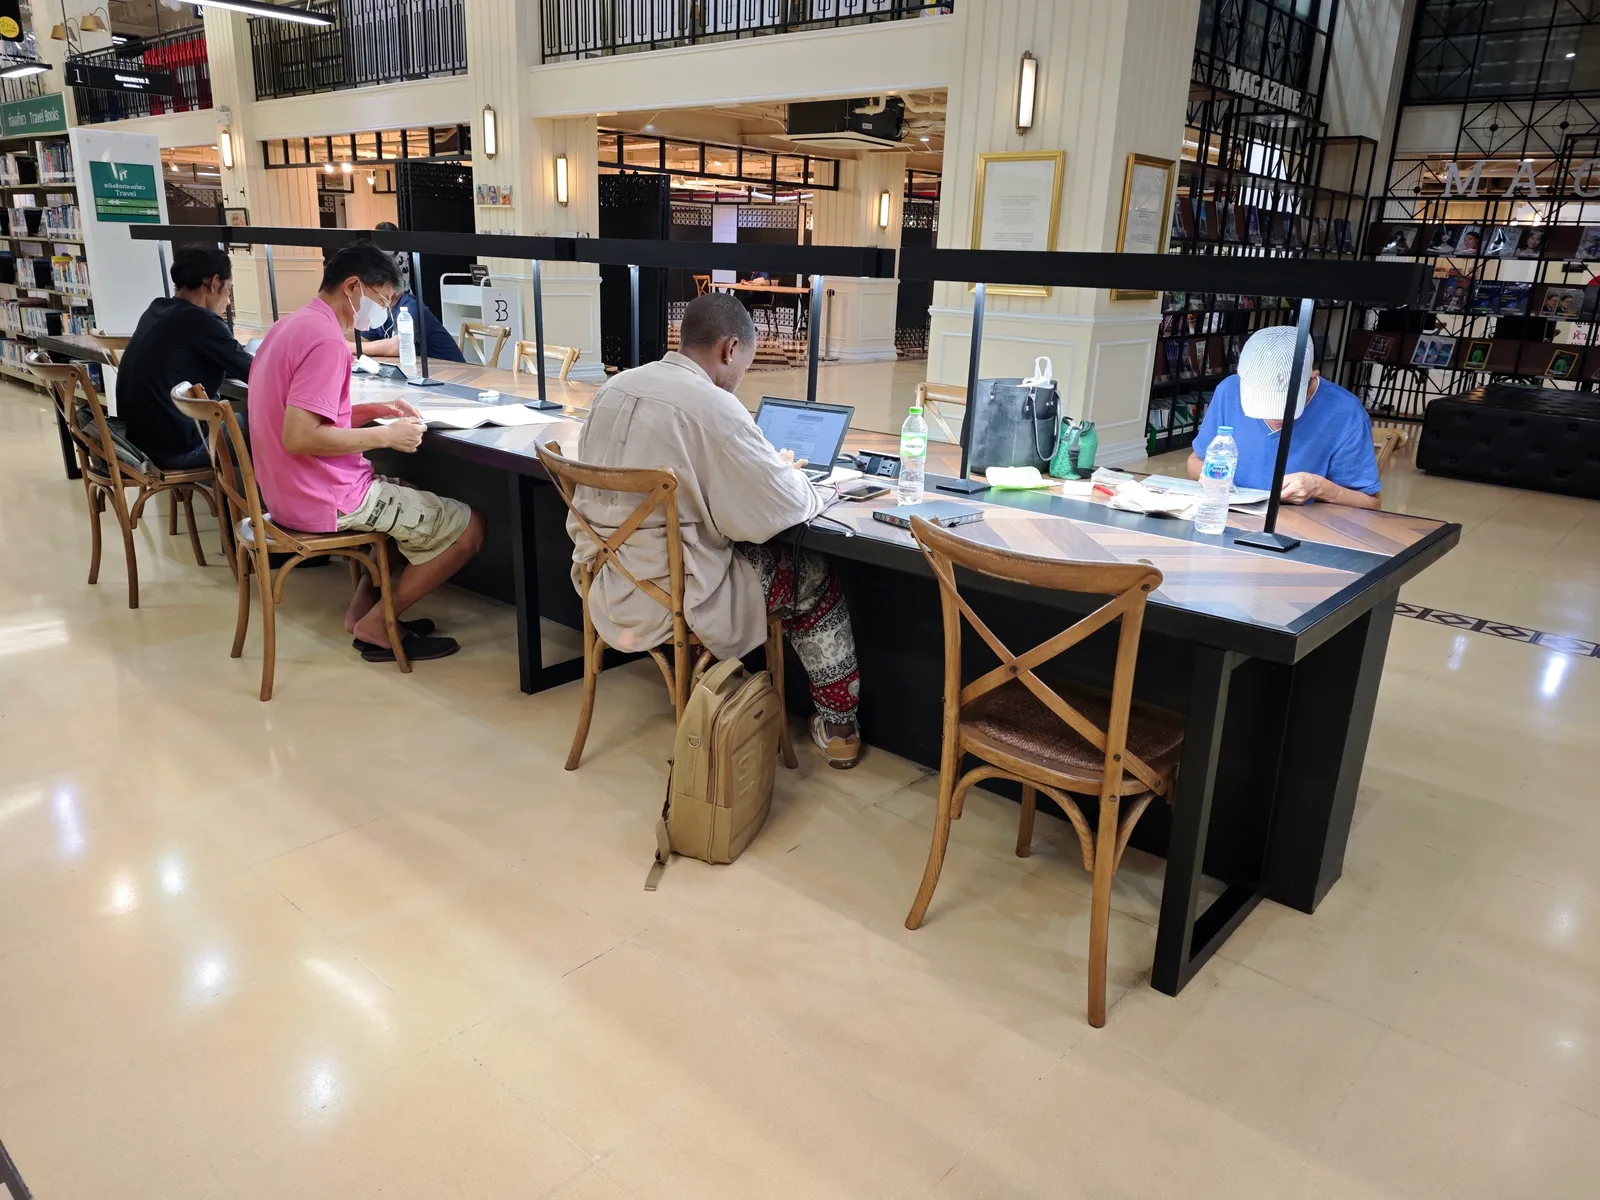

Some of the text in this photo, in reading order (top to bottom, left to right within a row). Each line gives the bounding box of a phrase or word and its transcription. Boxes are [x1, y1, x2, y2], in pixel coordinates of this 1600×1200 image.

[73, 69, 83, 83] 1
[1228, 66, 1301, 113] MAGAZINE
[29, 108, 44, 124] Travel
[44, 107, 60, 122] Books
[114, 189, 137, 197] Travel
